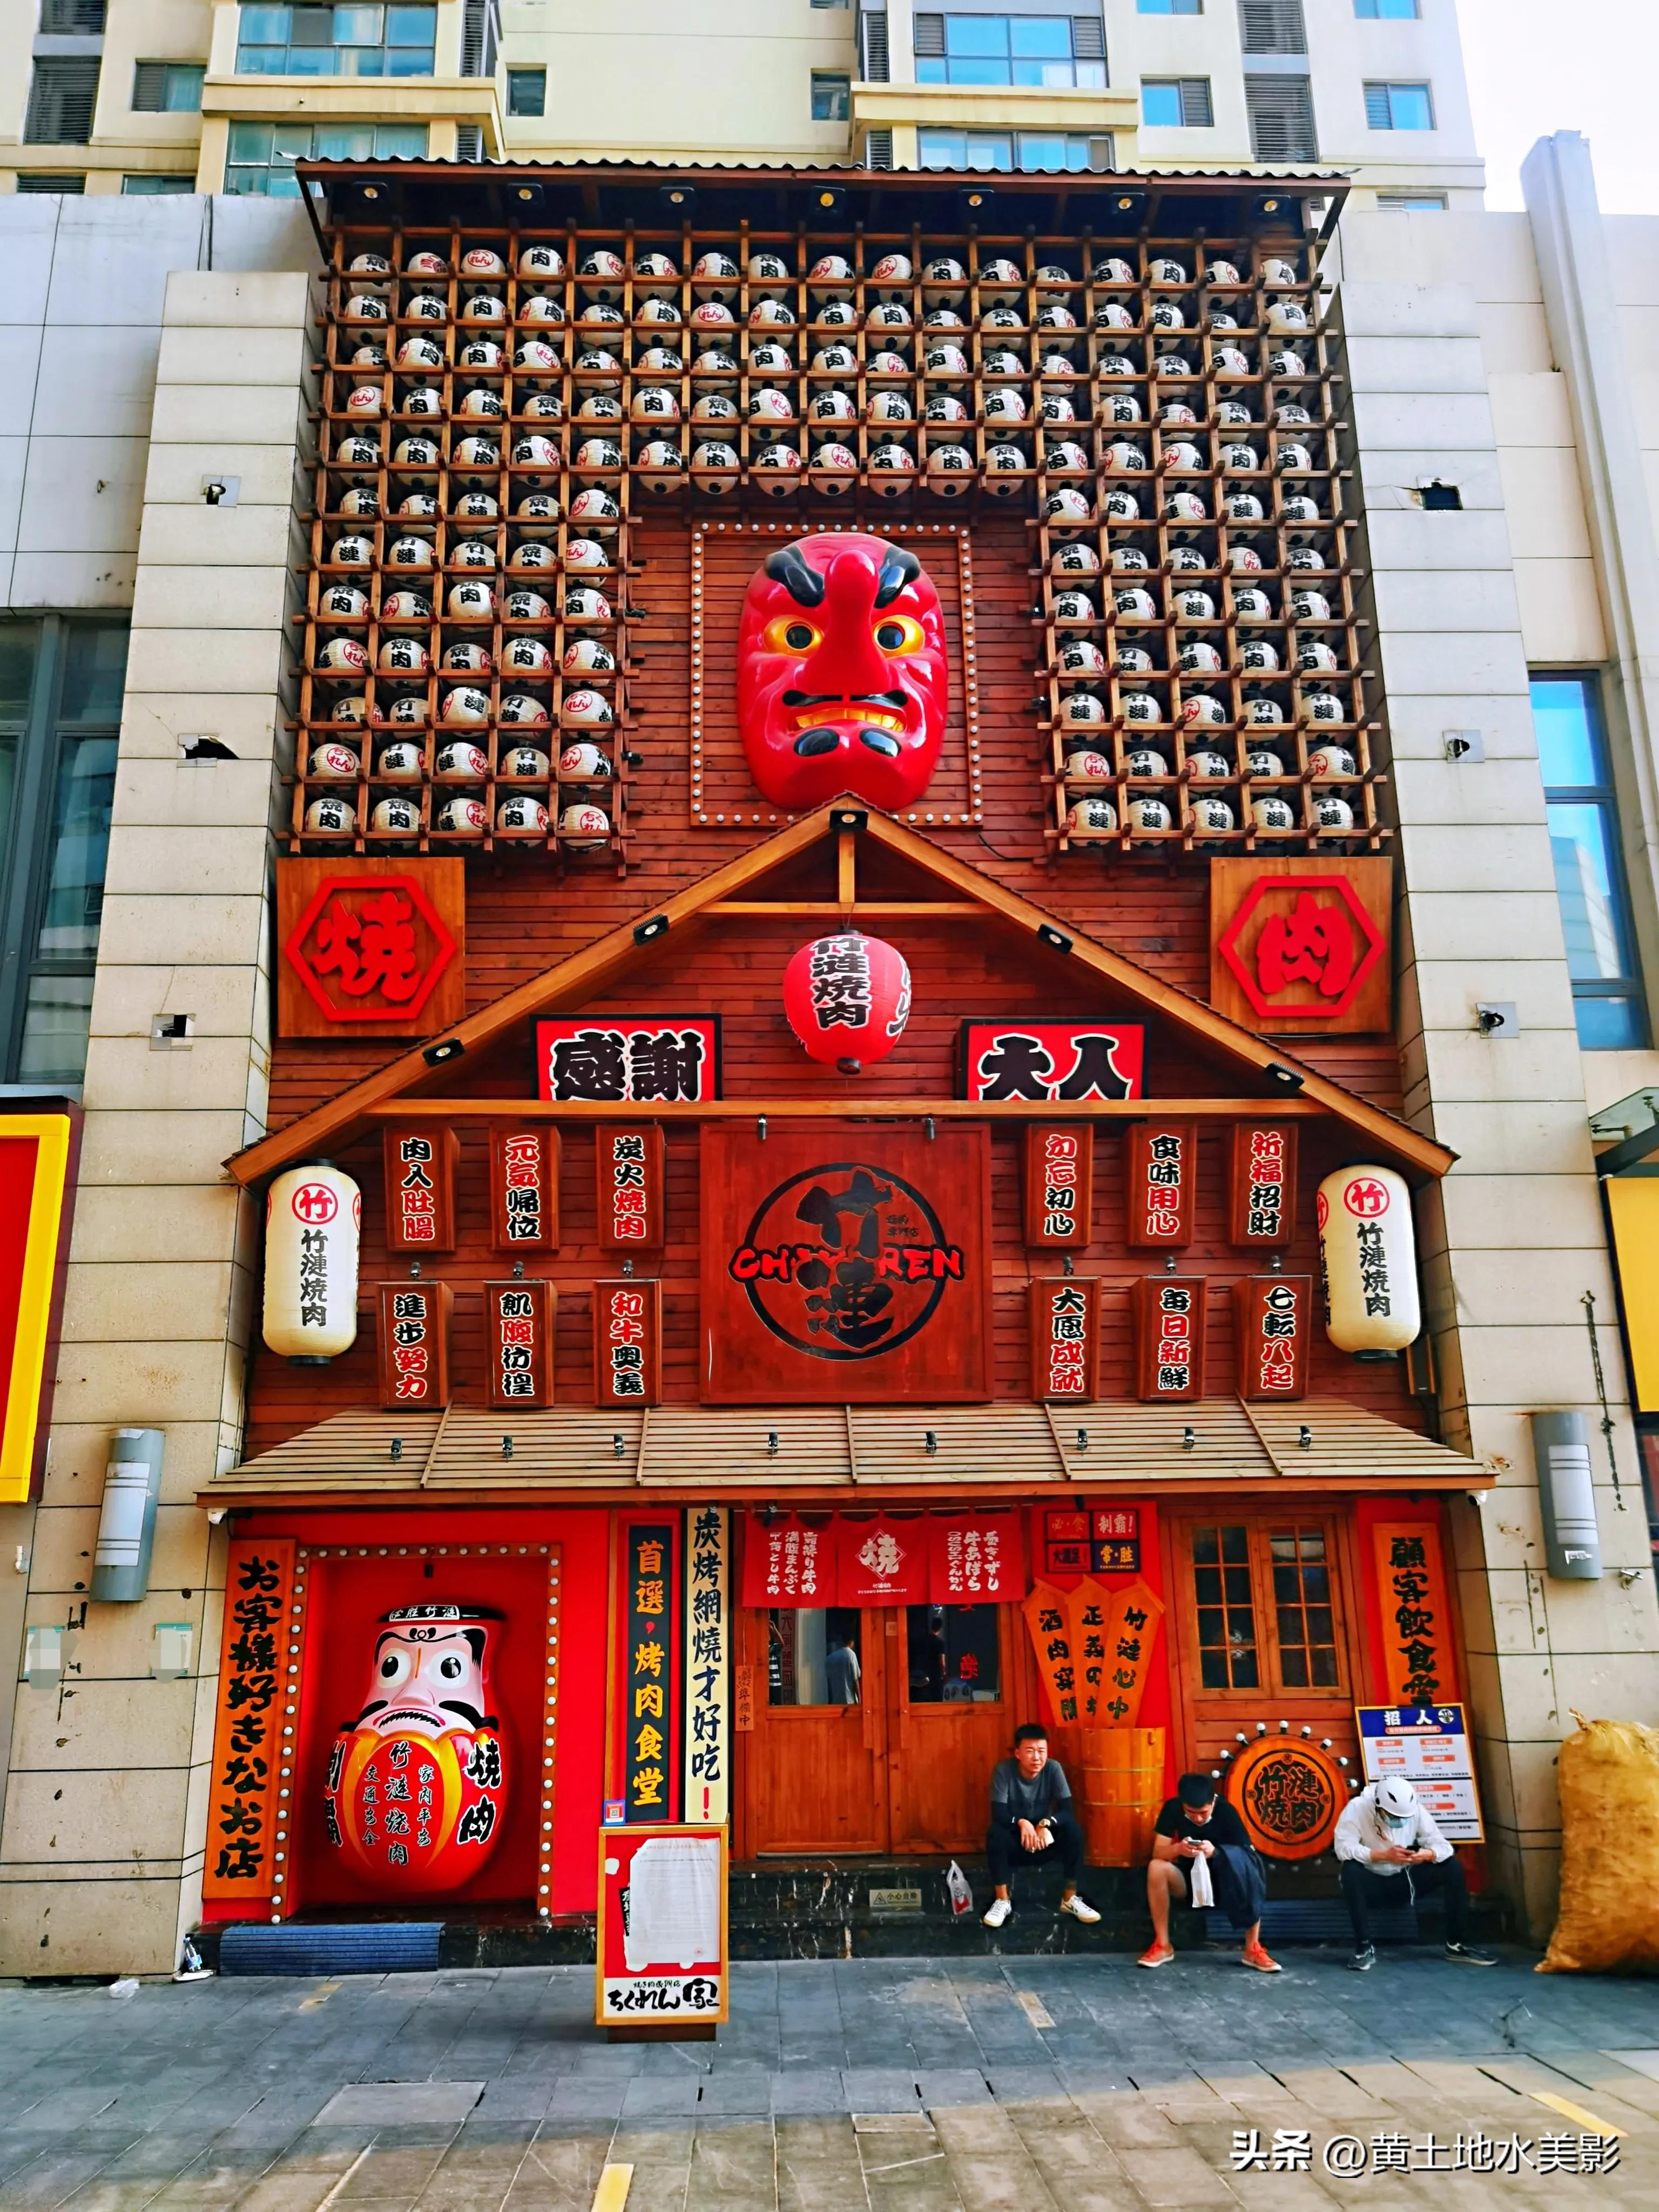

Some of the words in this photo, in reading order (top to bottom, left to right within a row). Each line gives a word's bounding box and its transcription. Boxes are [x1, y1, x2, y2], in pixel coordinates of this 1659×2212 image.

[549, 1029, 705, 1101] 感謝
[299, 1189, 333, 1219] 竹
[1044, 1135, 1077, 1237] 勿忘初心
[1146, 1134, 1182, 1236] 食味用心
[1247, 1132, 1284, 1236] 祈福招財
[1352, 1183, 1384, 1212] 竹
